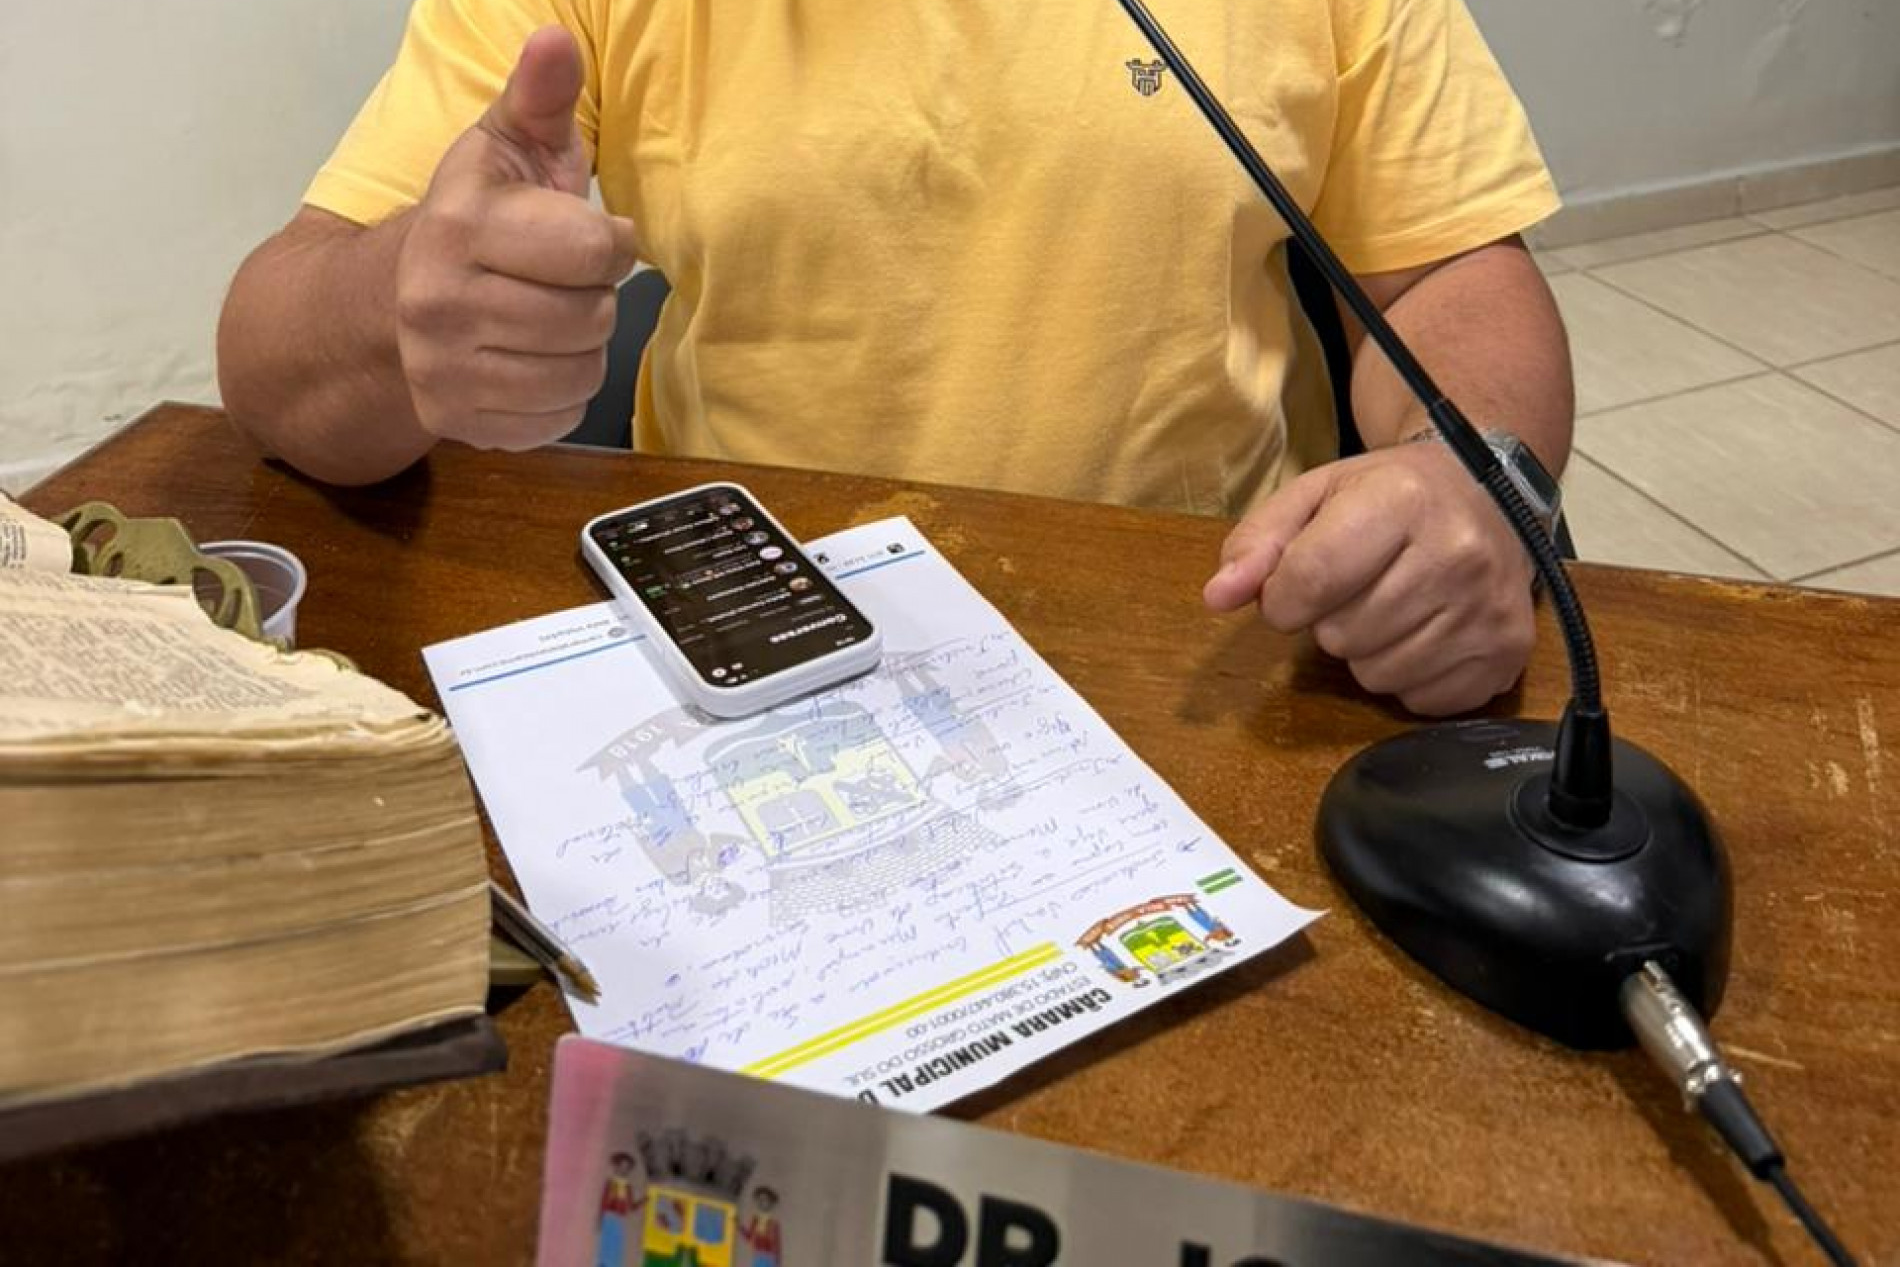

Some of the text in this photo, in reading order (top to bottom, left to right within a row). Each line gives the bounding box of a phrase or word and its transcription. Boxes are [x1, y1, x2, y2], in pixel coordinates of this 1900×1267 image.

[1034, 975, 1092, 1005] ESTADO
[968, 1009, 1012, 1035] MATO
[1011, 987, 1113, 1039] CÂMARA
[1012, 998, 1034, 1018] DE
[904, 1029, 967, 1062] GROSSO
[876, 1054, 902, 1076] DO
[882, 1029, 1014, 1098] MUNICIPAL
